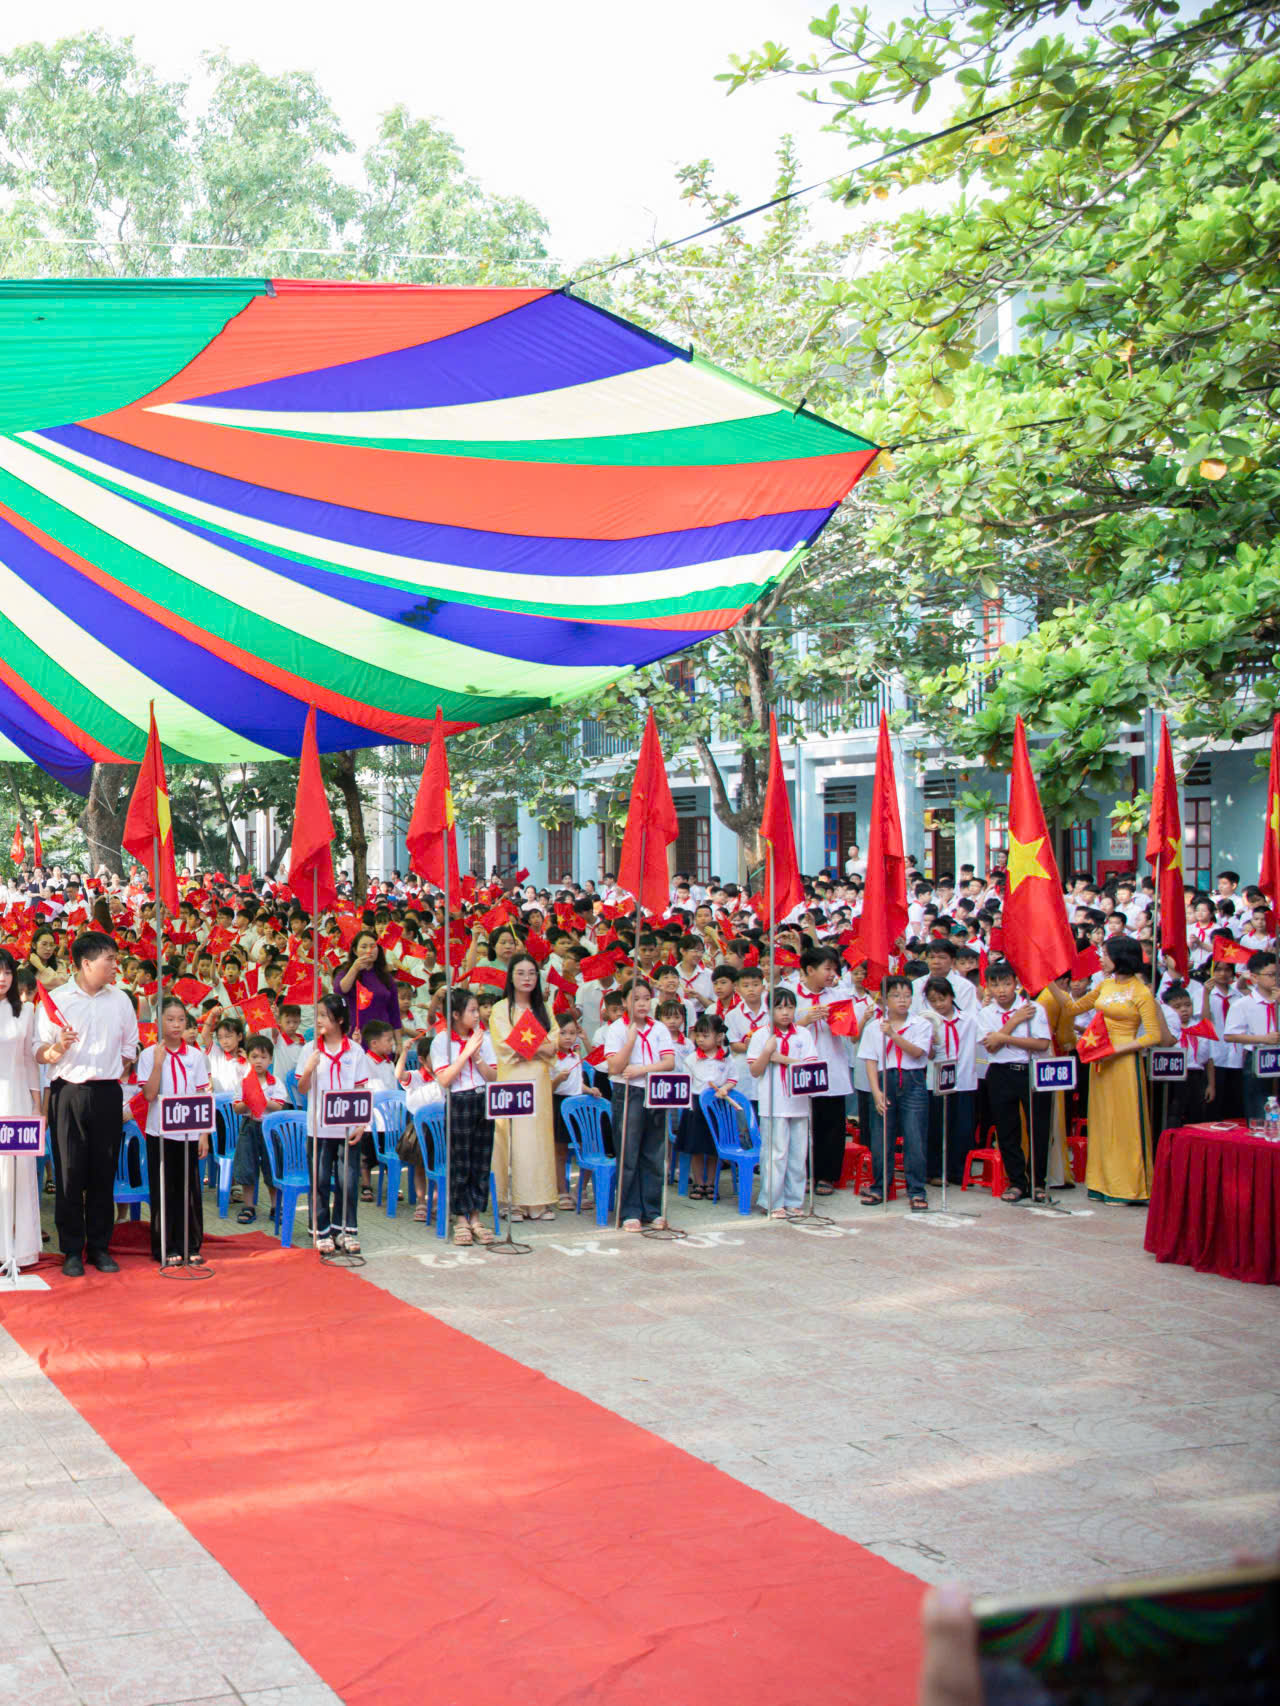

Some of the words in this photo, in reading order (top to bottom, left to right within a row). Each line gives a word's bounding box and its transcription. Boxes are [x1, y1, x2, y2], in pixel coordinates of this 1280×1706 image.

[1260, 1052, 1275, 1068] LỚP
[793, 1069, 811, 1088] LỚP
[813, 1069, 827, 1086] 1A
[1040, 1065, 1056, 1081] LỚP
[1057, 1066, 1068, 1080] 6B
[491, 1088, 515, 1109] LỚP
[516, 1090, 532, 1108] 1C
[651, 1079, 671, 1099] LỚP
[674, 1082, 688, 1099] 1B
[165, 1102, 189, 1125] LỚP
[193, 1104, 210, 1122] 1E
[327, 1097, 350, 1117] LỚP
[352, 1099, 369, 1117] 1D
[15, 1126, 38, 1143] 10K
